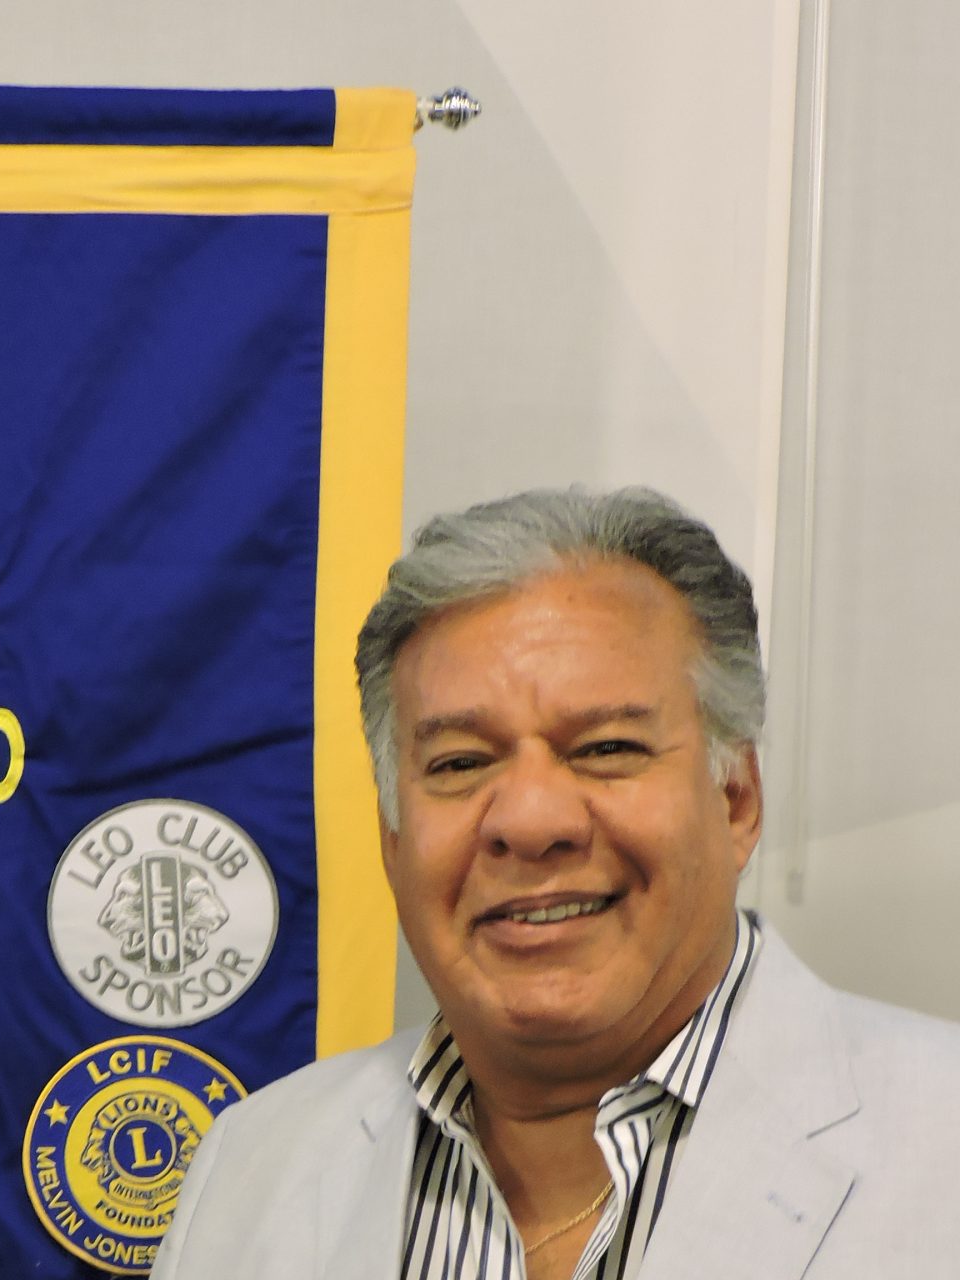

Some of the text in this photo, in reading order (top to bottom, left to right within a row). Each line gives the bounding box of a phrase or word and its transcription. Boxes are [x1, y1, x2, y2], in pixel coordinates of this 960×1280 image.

[67, 813, 249, 890] LEO CLUB
[150, 861, 177, 962] LEO
[78, 947, 254, 1017] SPONSOR
[86, 1048, 173, 1085] LCIF
[101, 1097, 172, 1124] LIONS
[127, 1127, 163, 1169] L
[36, 1145, 85, 1236] MELVIN
